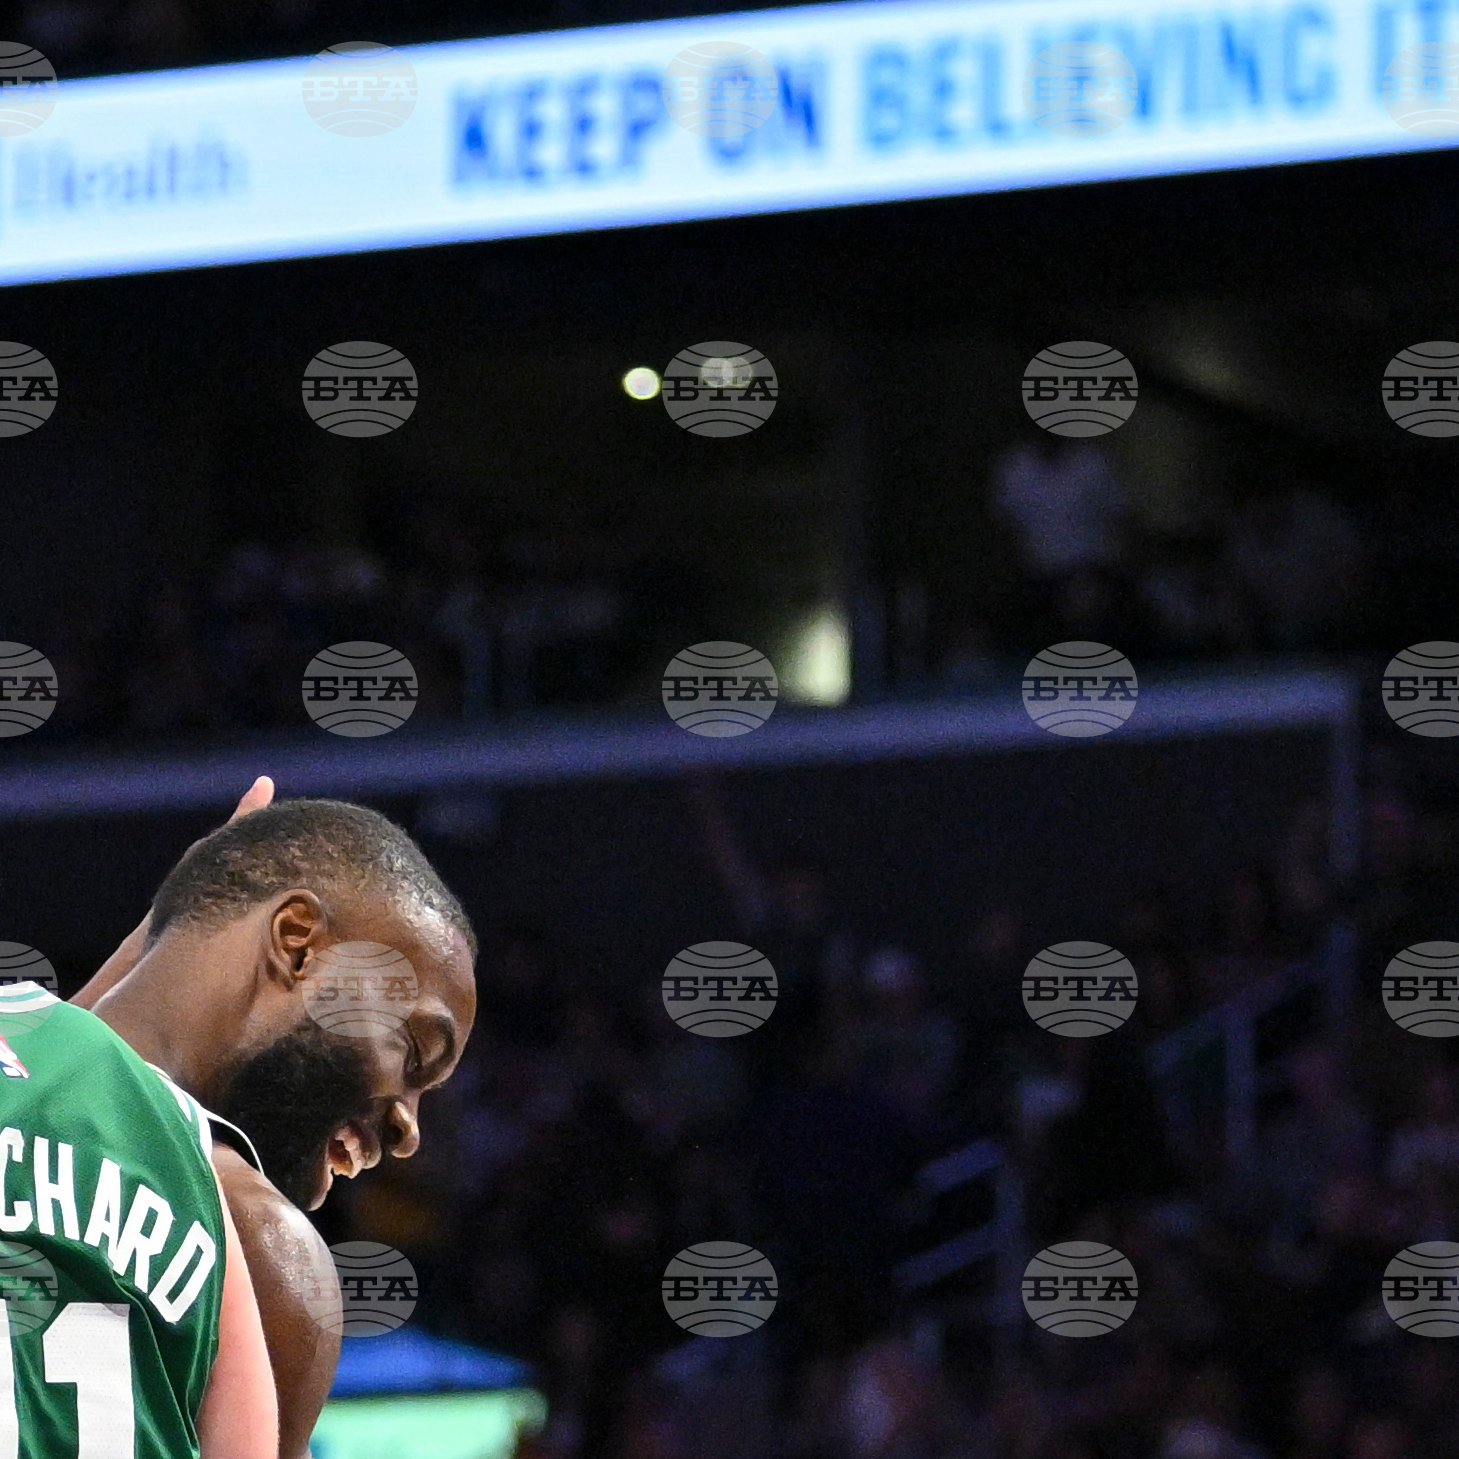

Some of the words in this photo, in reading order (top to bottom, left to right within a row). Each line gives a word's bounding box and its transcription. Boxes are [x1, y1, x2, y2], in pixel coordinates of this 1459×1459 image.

[452, 70, 664, 186] KEEP
[704, 52, 824, 168] ON
[866, 8, 1336, 152] BELIEVING
